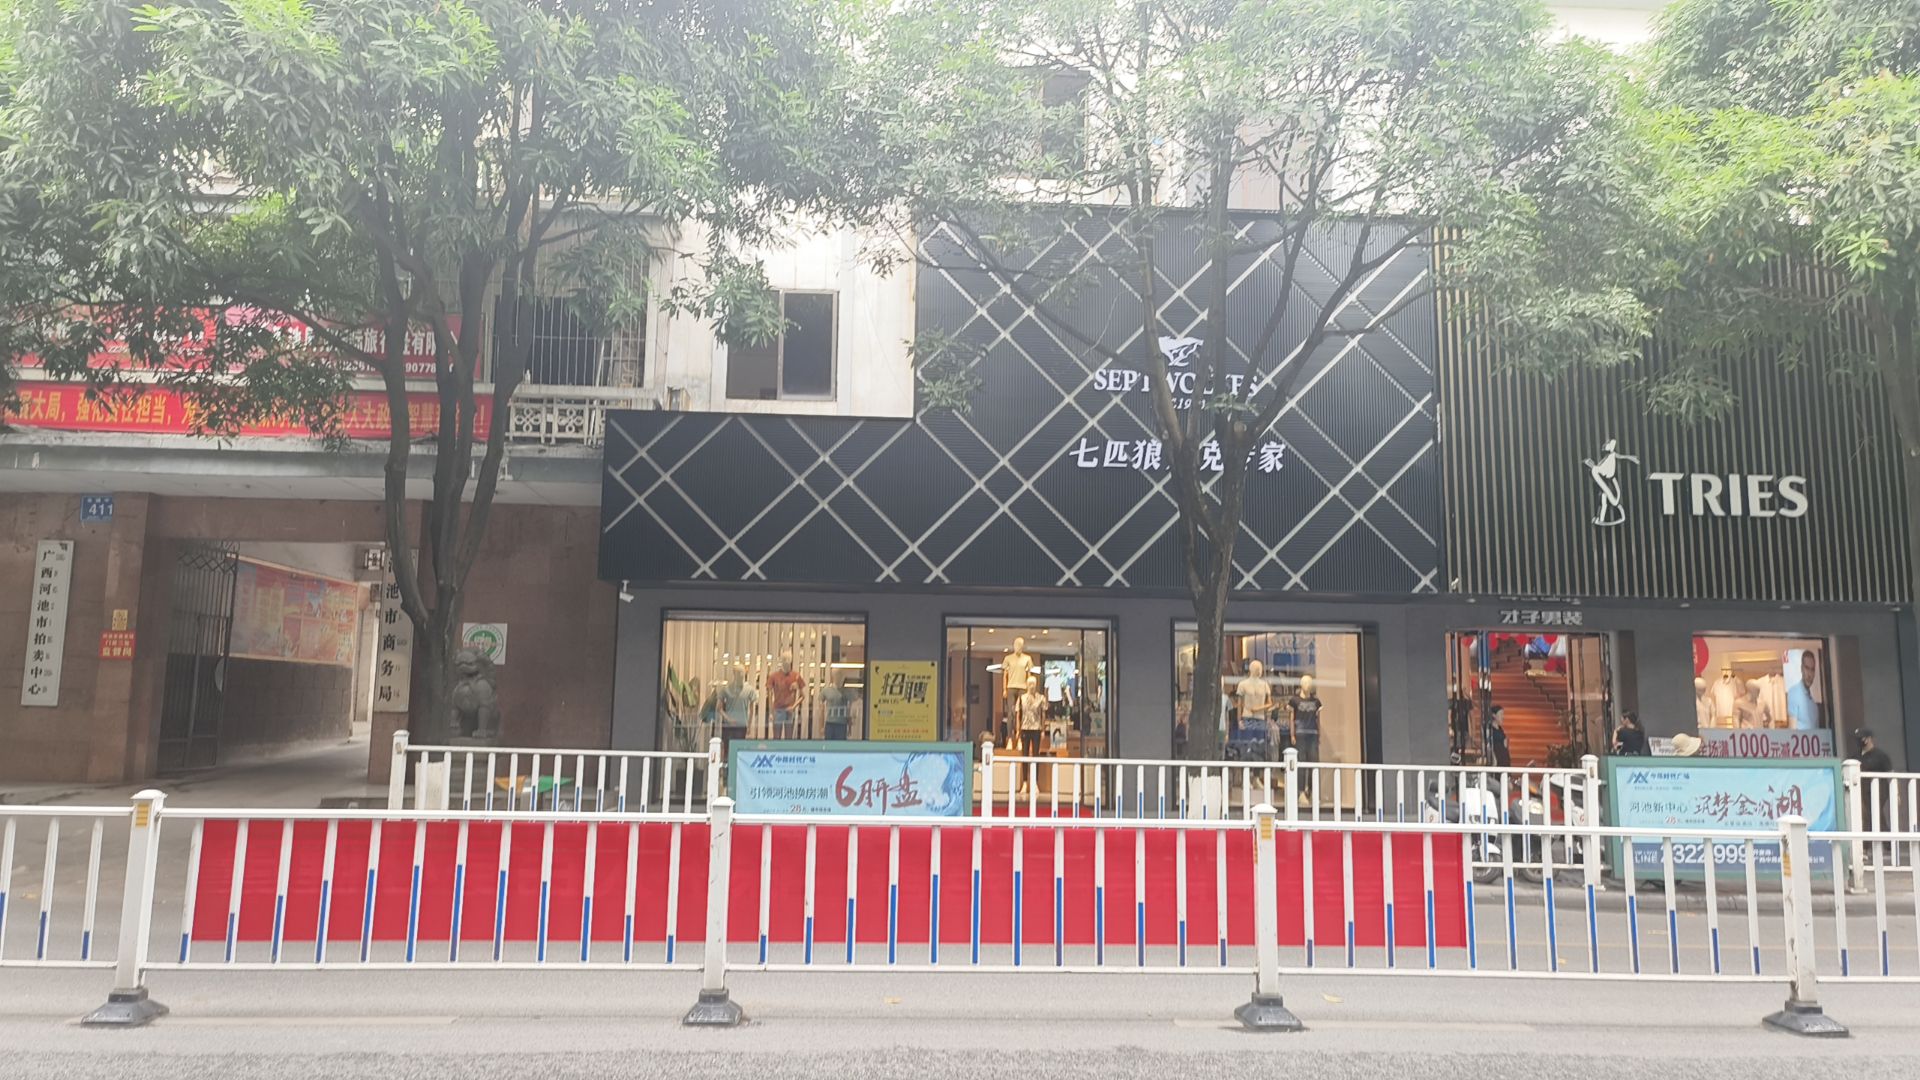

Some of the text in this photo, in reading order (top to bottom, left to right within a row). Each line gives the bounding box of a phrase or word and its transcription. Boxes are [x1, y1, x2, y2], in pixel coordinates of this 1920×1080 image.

[1069, 438, 1286, 474] 七匹狼克家
[88, 503, 113, 516] 411
[1648, 472, 1809, 518] TRIES
[28, 549, 55, 696] 广西河池市拍卖中心
[378, 557, 401, 702] 池市商务局
[1500, 610, 1583, 626] 才子男装
[881, 672, 928, 704] 招聘
[750, 786, 829, 800] 引领河池换房潮
